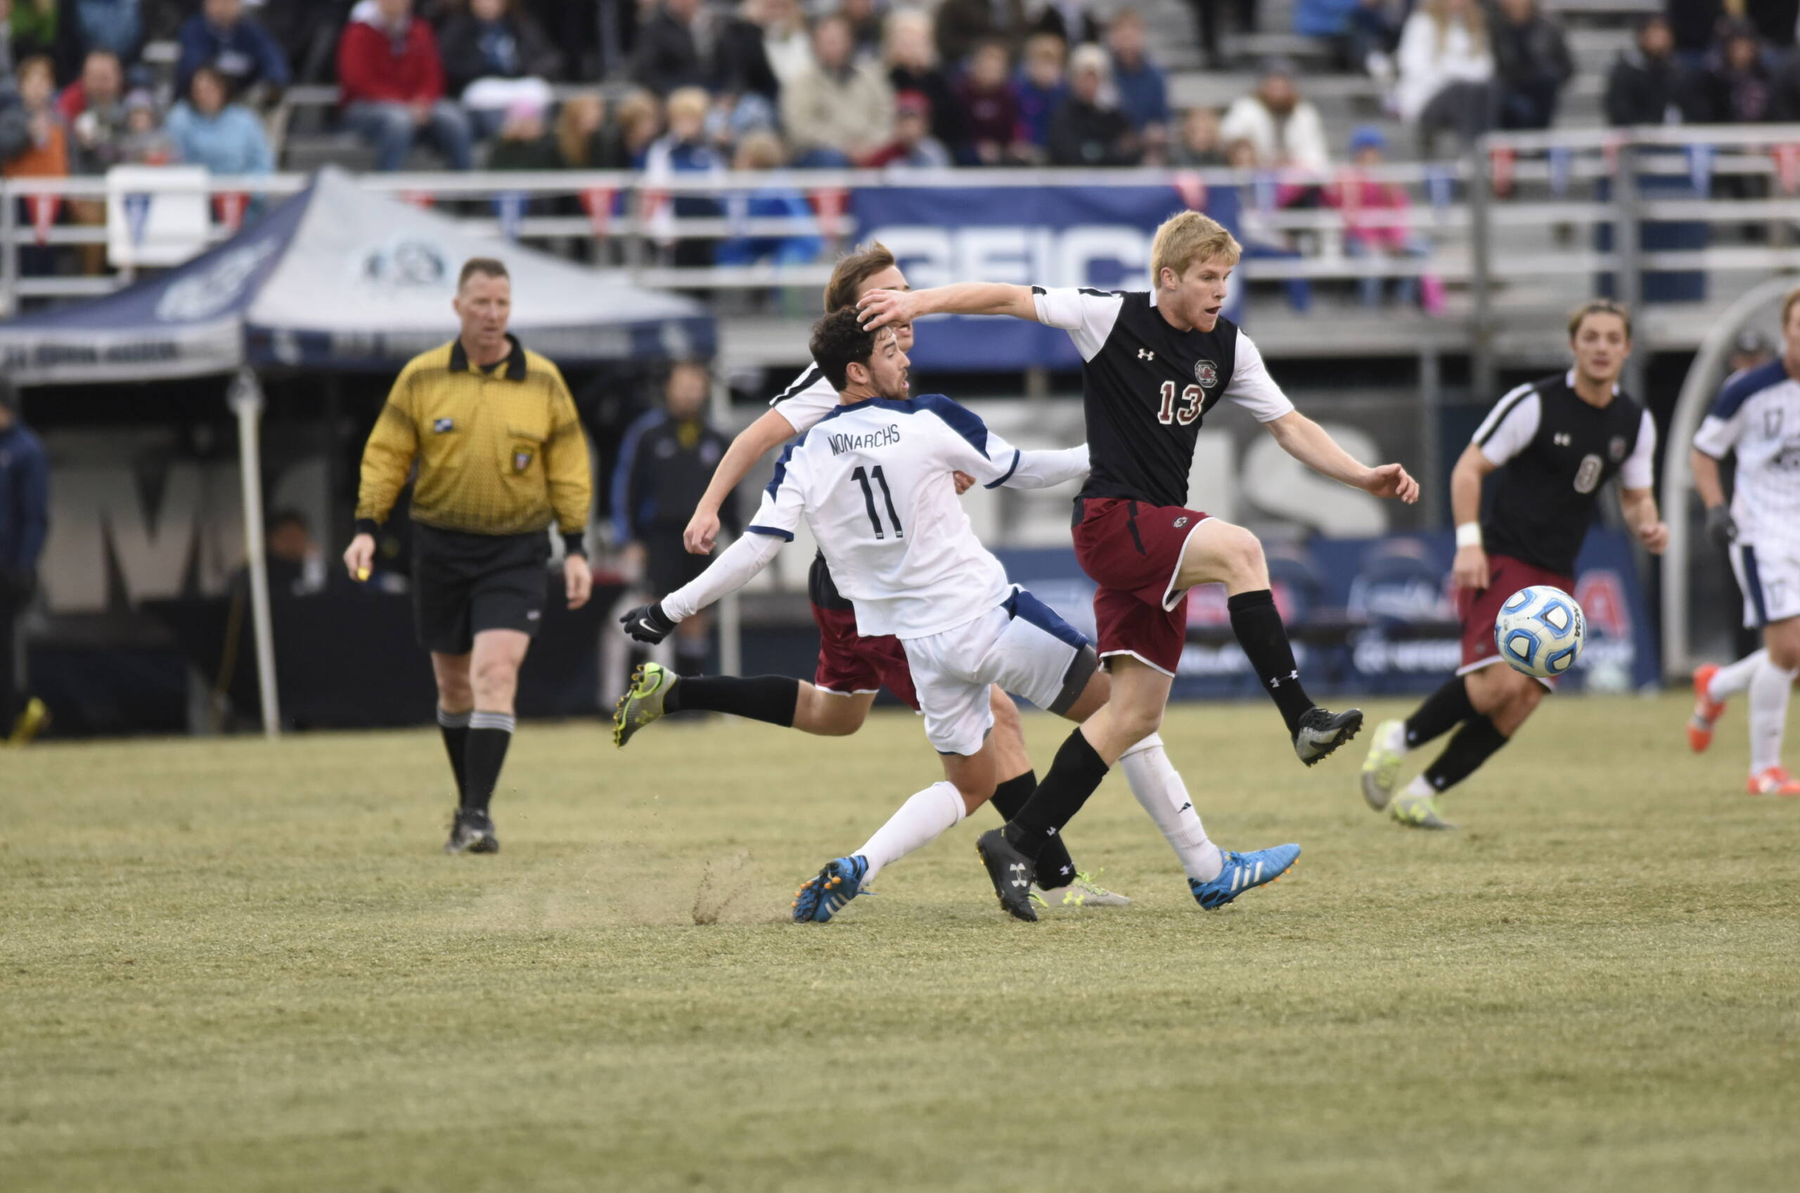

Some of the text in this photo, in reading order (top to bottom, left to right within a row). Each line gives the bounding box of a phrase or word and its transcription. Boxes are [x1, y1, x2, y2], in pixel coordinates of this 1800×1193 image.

[867, 225, 1241, 322] GEIC
[1157, 380, 1205, 426] 13
[850, 464, 904, 540] 11
